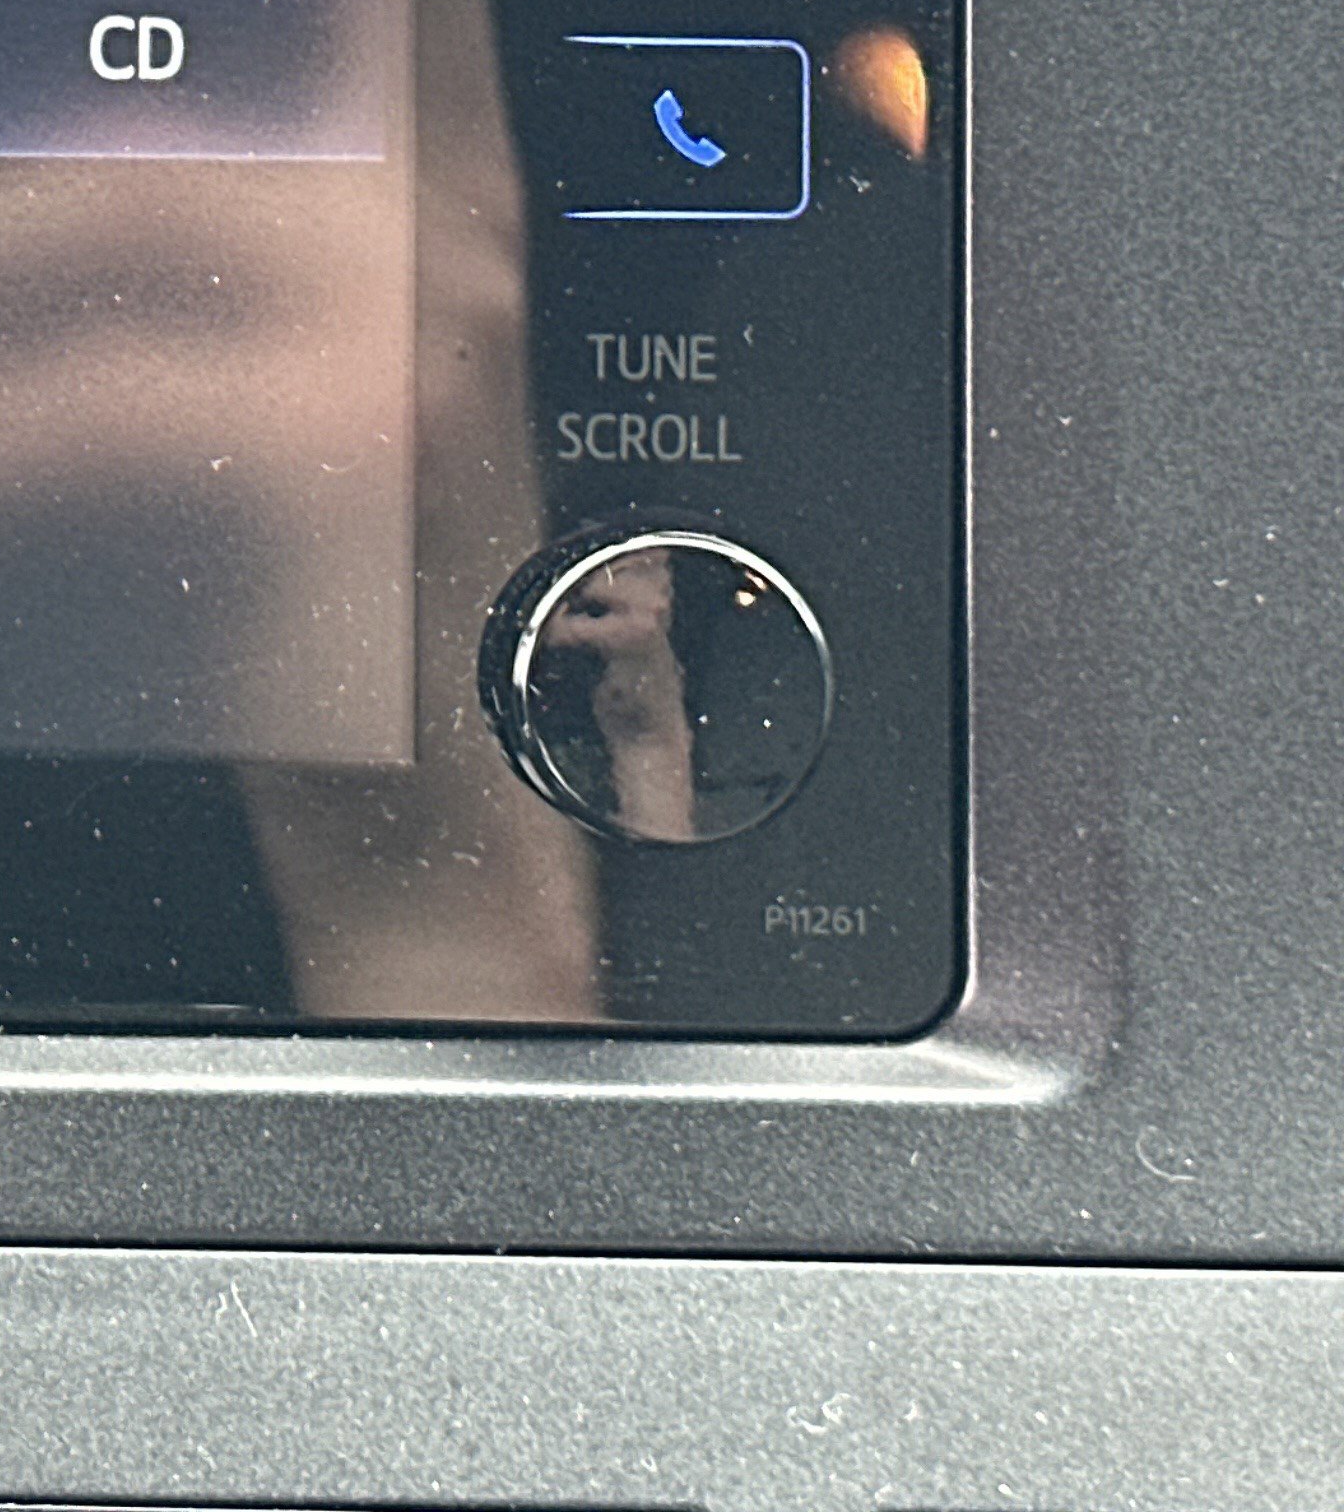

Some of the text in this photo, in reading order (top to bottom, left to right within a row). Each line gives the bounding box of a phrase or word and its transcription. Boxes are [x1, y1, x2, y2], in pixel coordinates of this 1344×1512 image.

[89, 16, 185, 81] CD
[587, 335, 716, 380] TUNE
[558, 414, 742, 460] SCROLL
[765, 904, 866, 936] P11261
